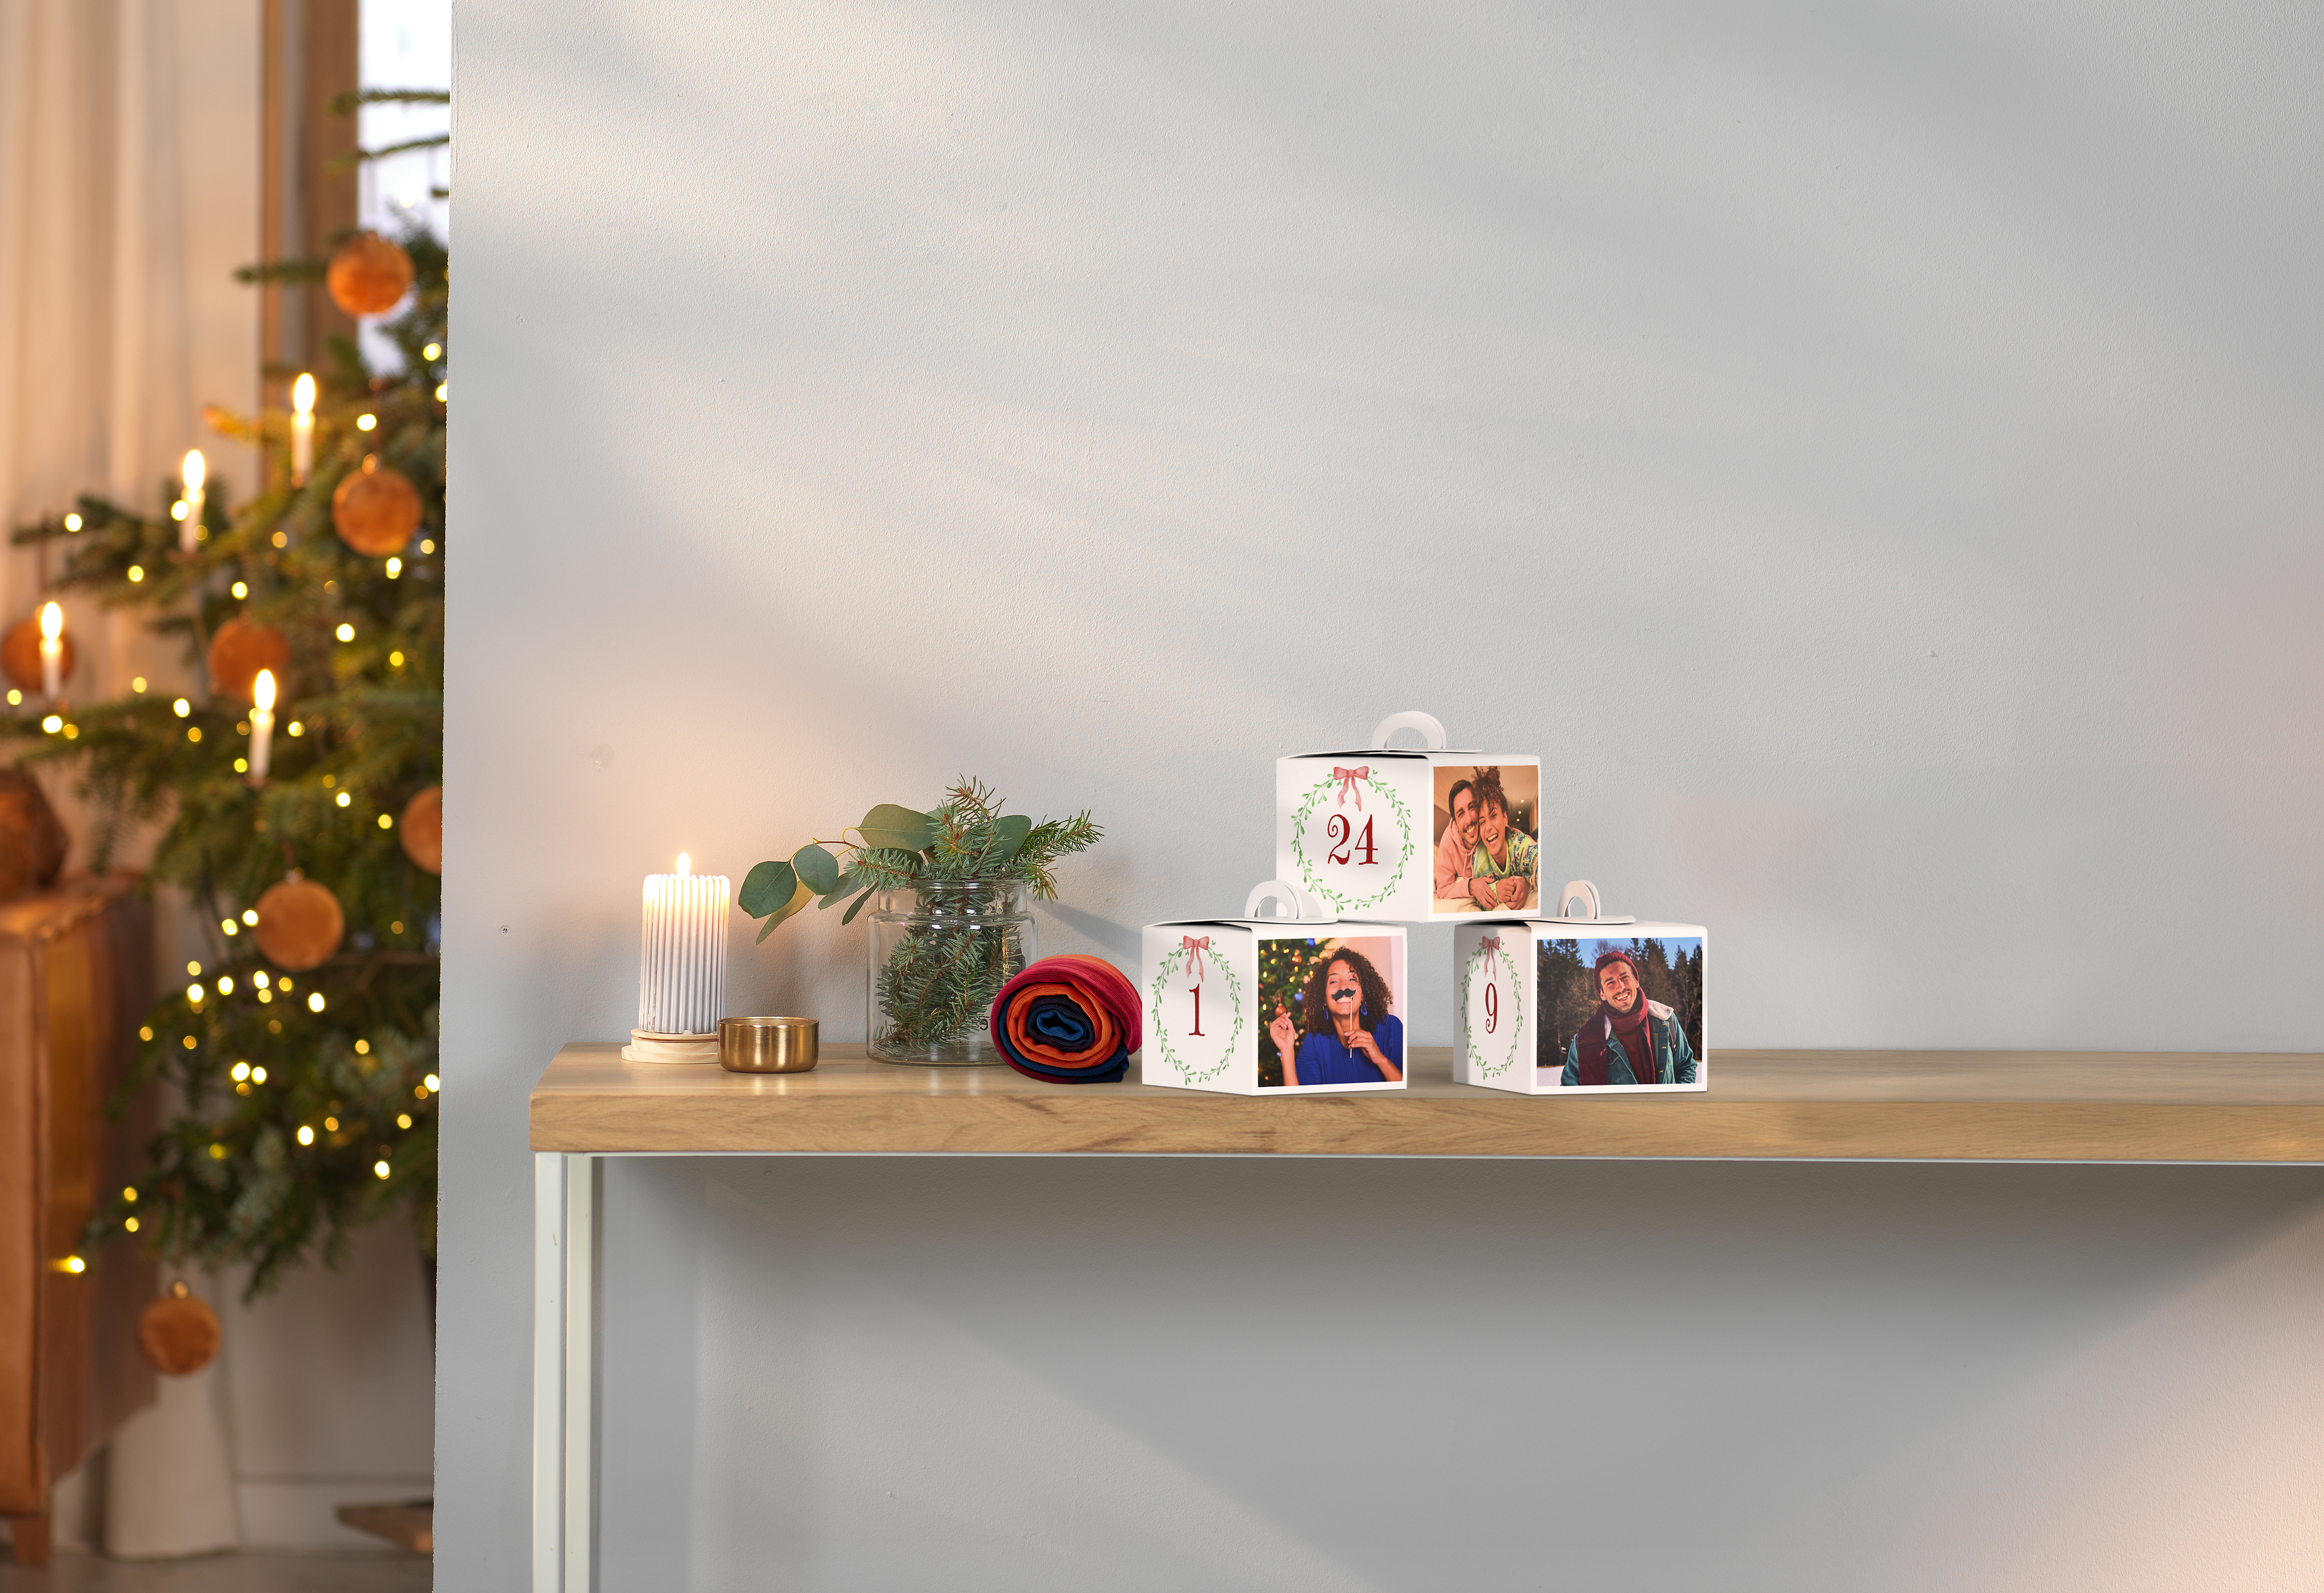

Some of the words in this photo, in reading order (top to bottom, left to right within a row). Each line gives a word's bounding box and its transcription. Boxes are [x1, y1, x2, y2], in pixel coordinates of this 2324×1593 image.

[1327, 813, 1379, 866] 24
[1188, 983, 1205, 1037] 1
[1485, 982, 1498, 1035] 9
